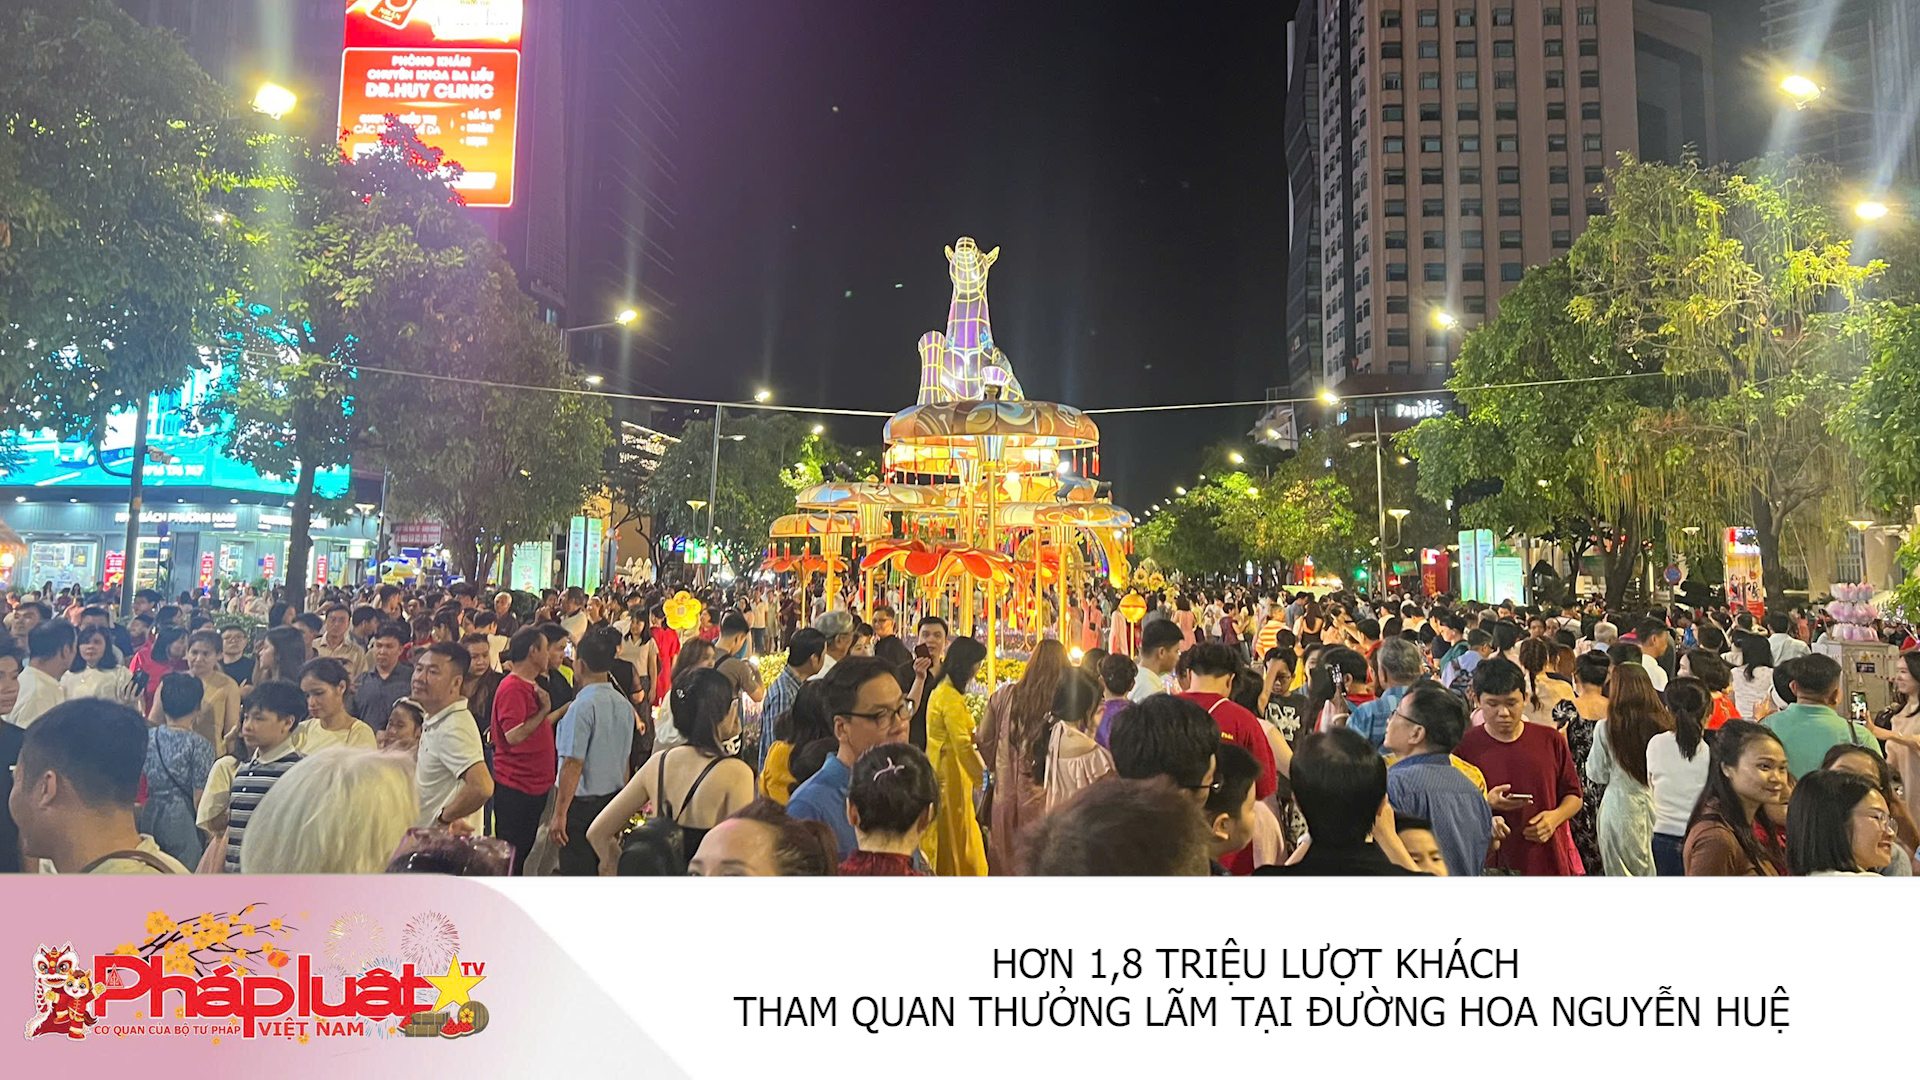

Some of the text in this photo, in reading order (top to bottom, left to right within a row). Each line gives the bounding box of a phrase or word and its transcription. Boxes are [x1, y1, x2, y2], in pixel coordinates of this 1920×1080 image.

[415, 69, 450, 81] KHOA
[365, 82, 494, 99] DR.HUY CLINIC
